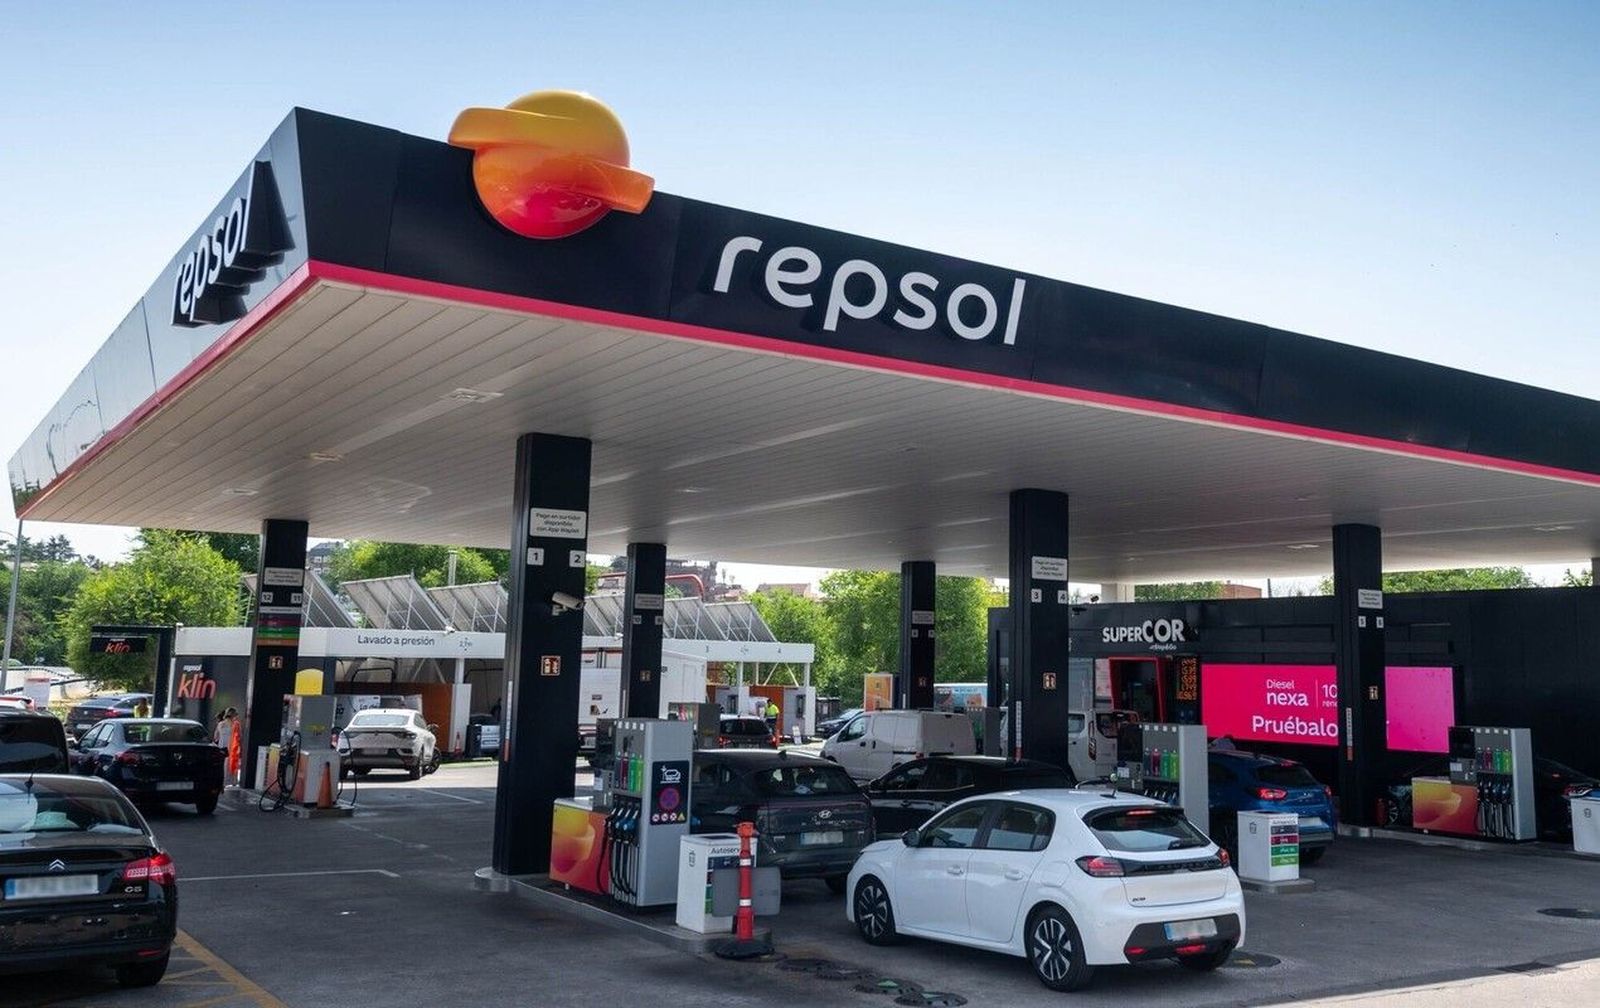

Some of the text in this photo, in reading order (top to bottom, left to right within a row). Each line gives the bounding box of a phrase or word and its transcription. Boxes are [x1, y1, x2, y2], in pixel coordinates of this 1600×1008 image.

[171, 161, 256, 326] repsol
[713, 236, 1026, 345] repsol
[534, 552, 538, 561] 1
[574, 554, 581, 564] 2
[1034, 592, 1039, 600] 3
[1102, 619, 1186, 642] SUPERCOR
[357, 636, 392, 644] Lavado
[401, 636, 435, 646] presión
[177, 672, 217, 699] klin
[1266, 679, 1295, 689] Diesel
[1266, 692, 1309, 706] nexa
[1252, 715, 1338, 738] Pruébalo
